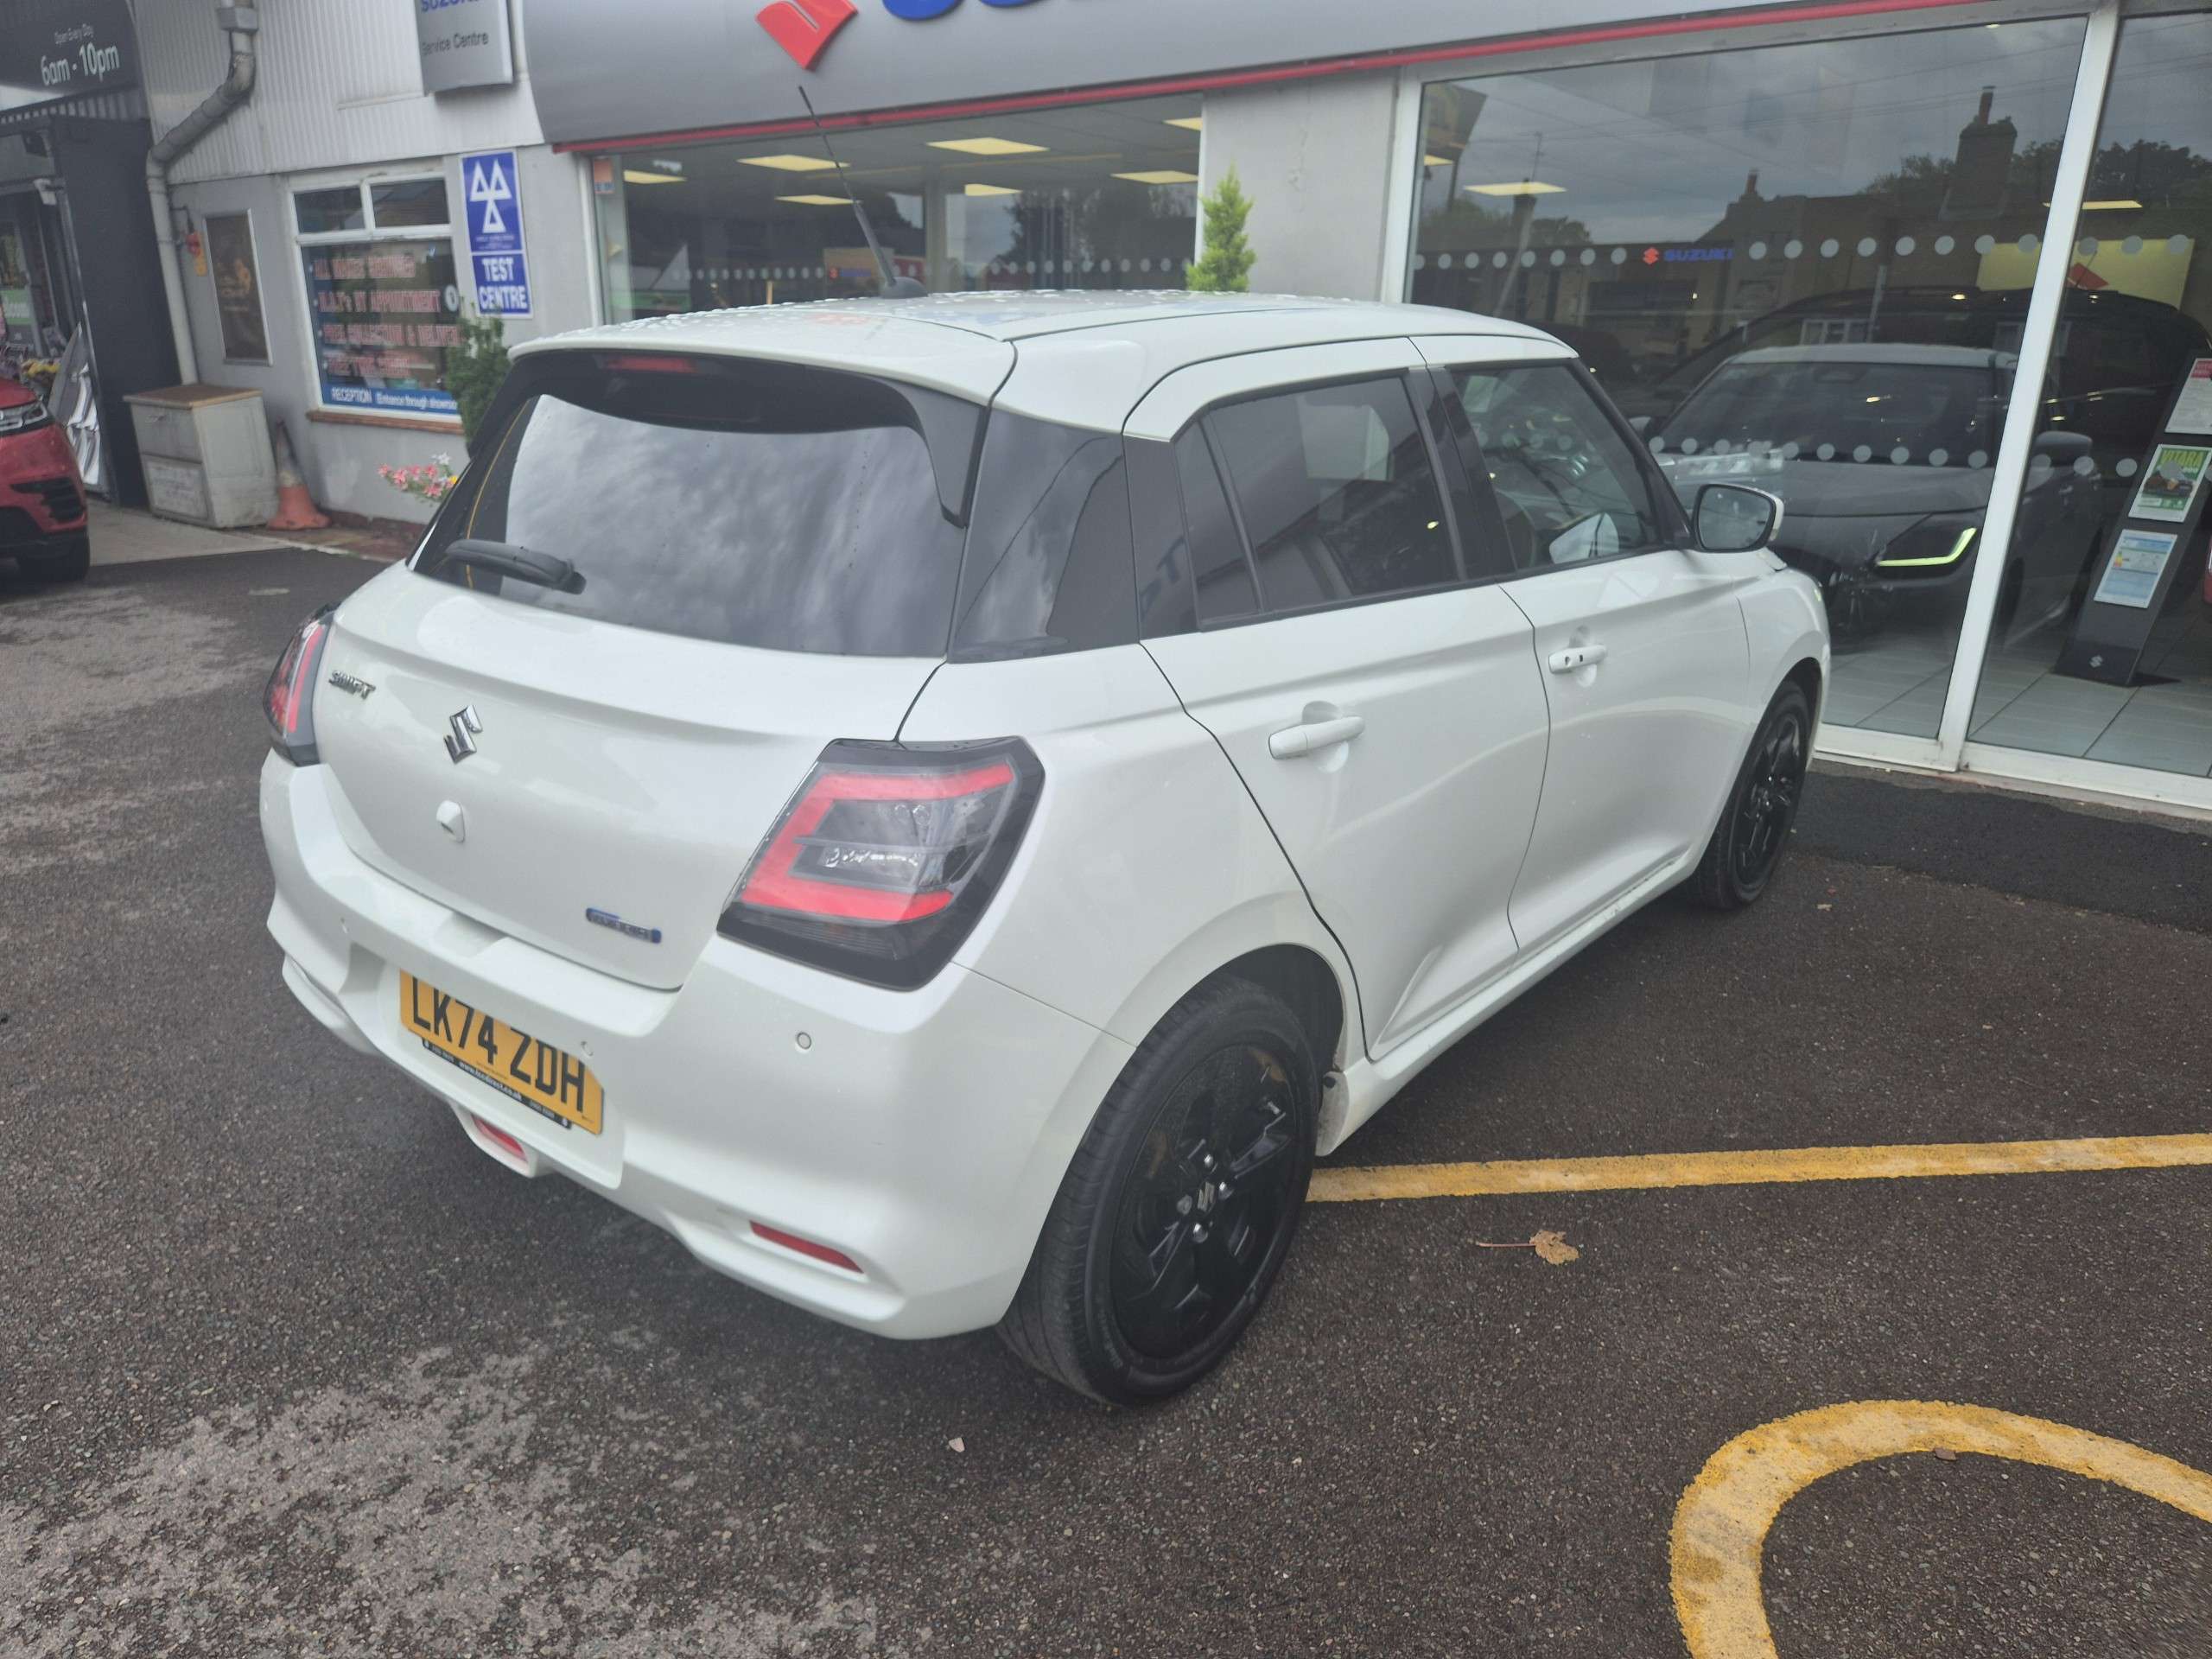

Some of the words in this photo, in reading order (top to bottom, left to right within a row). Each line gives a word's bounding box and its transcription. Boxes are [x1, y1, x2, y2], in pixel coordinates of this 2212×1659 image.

[453, 32, 489, 48] Centre
[41, 55, 70, 86] 6am
[79, 41, 120, 82] 10pm
[481, 257, 514, 282] TEST
[479, 286, 528, 309] CENTRE
[330, 387, 372, 404] RECEPTION
[411, 976, 499, 1066] LK74
[510, 1026, 586, 1113] ZDH
